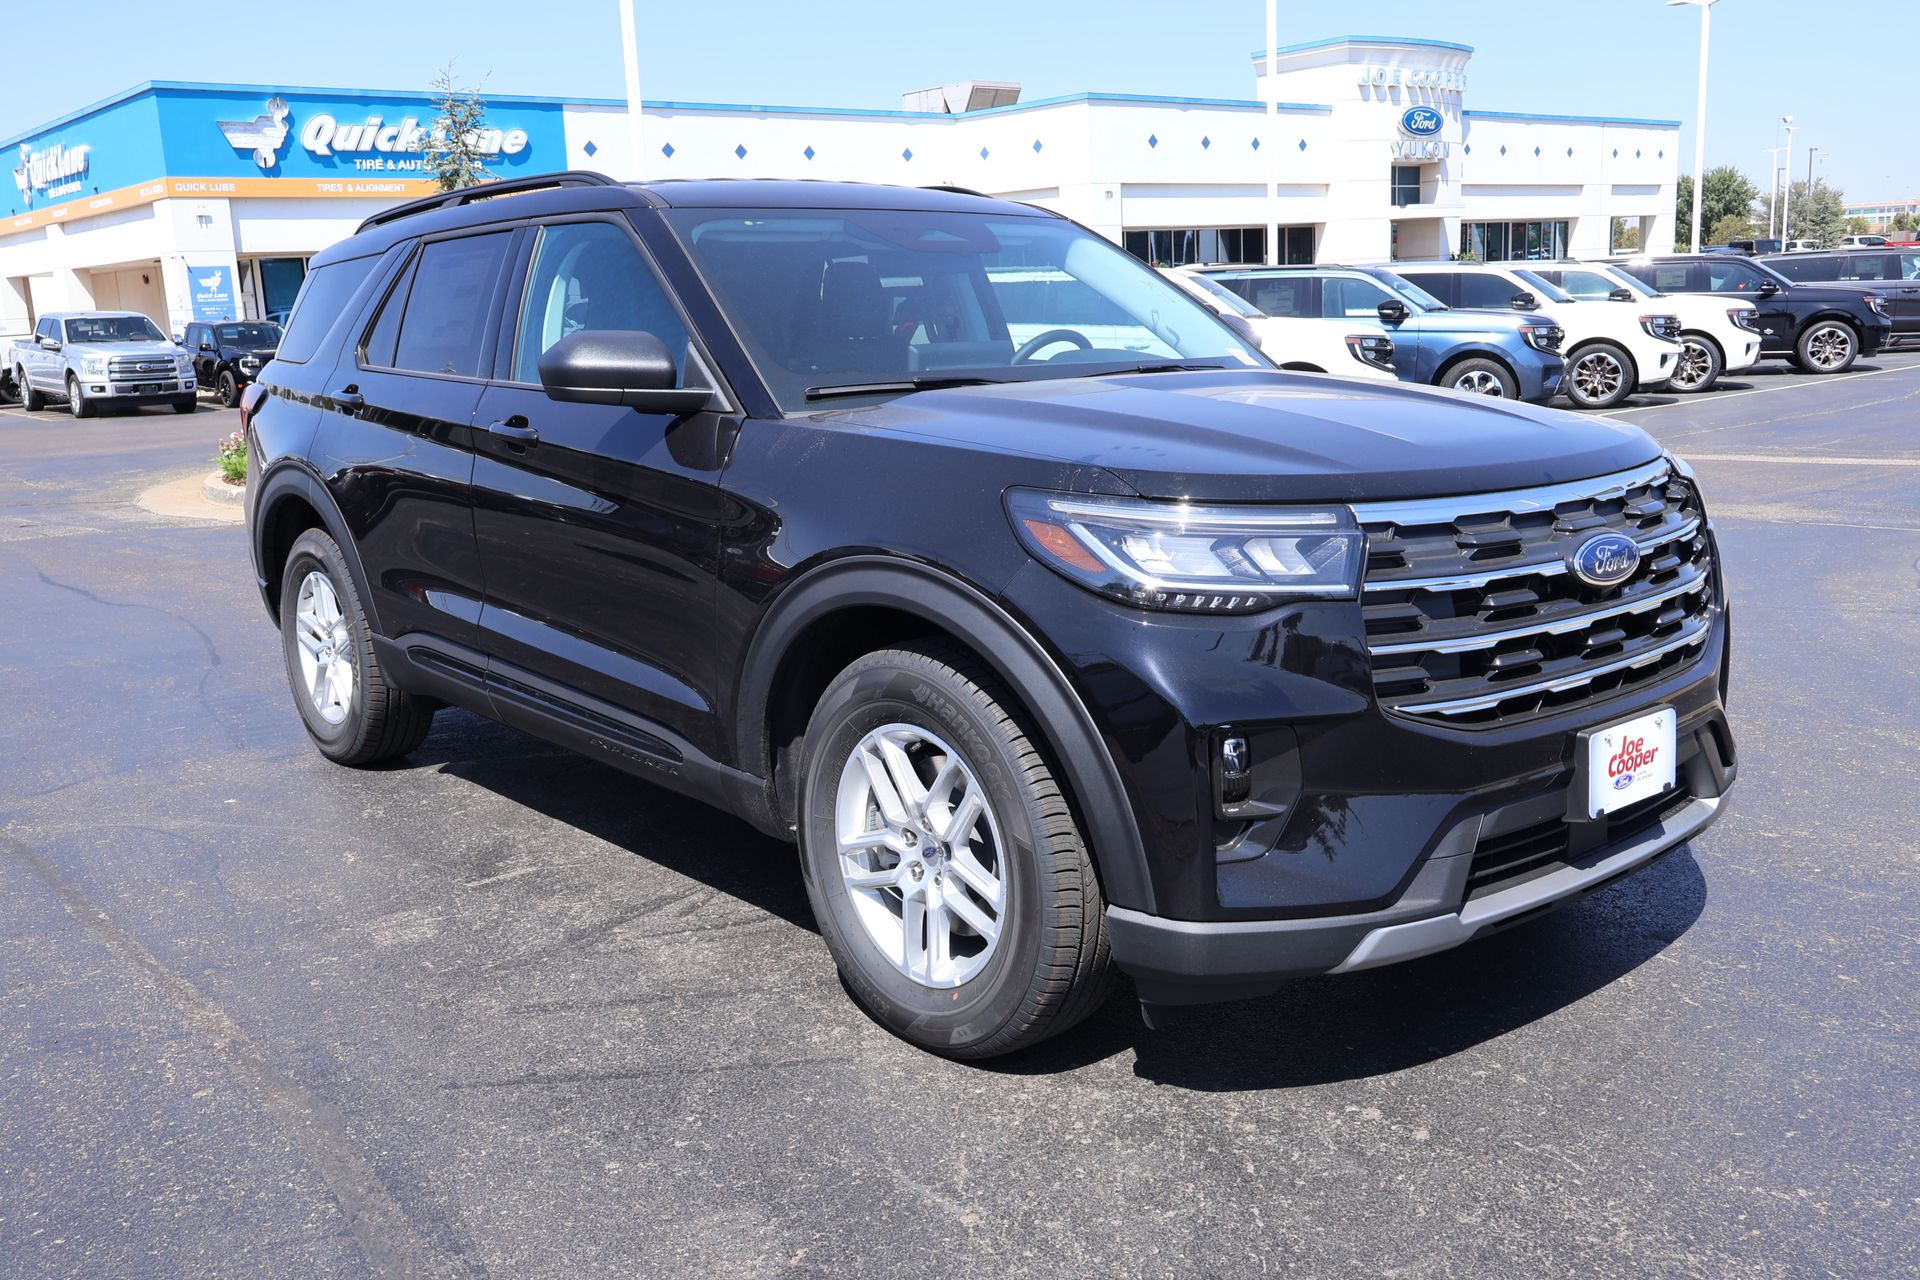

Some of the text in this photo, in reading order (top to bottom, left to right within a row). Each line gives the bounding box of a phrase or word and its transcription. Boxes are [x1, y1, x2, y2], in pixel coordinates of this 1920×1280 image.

[1358, 66, 1401, 86] JOE
[1411, 111, 1437, 130] Ford
[302, 113, 428, 155] Quick
[1394, 141, 1449, 160] YUKON
[354, 159, 384, 170] TIRE
[387, 159, 395, 170] &
[175, 183, 236, 192] QUICK LUBE
[316, 183, 344, 192] TIRES
[355, 183, 406, 192] ALIGNMENT
[1595, 544, 1630, 575] Ford
[1618, 736, 1644, 759] Joe
[1608, 747, 1659, 777] Cooper
